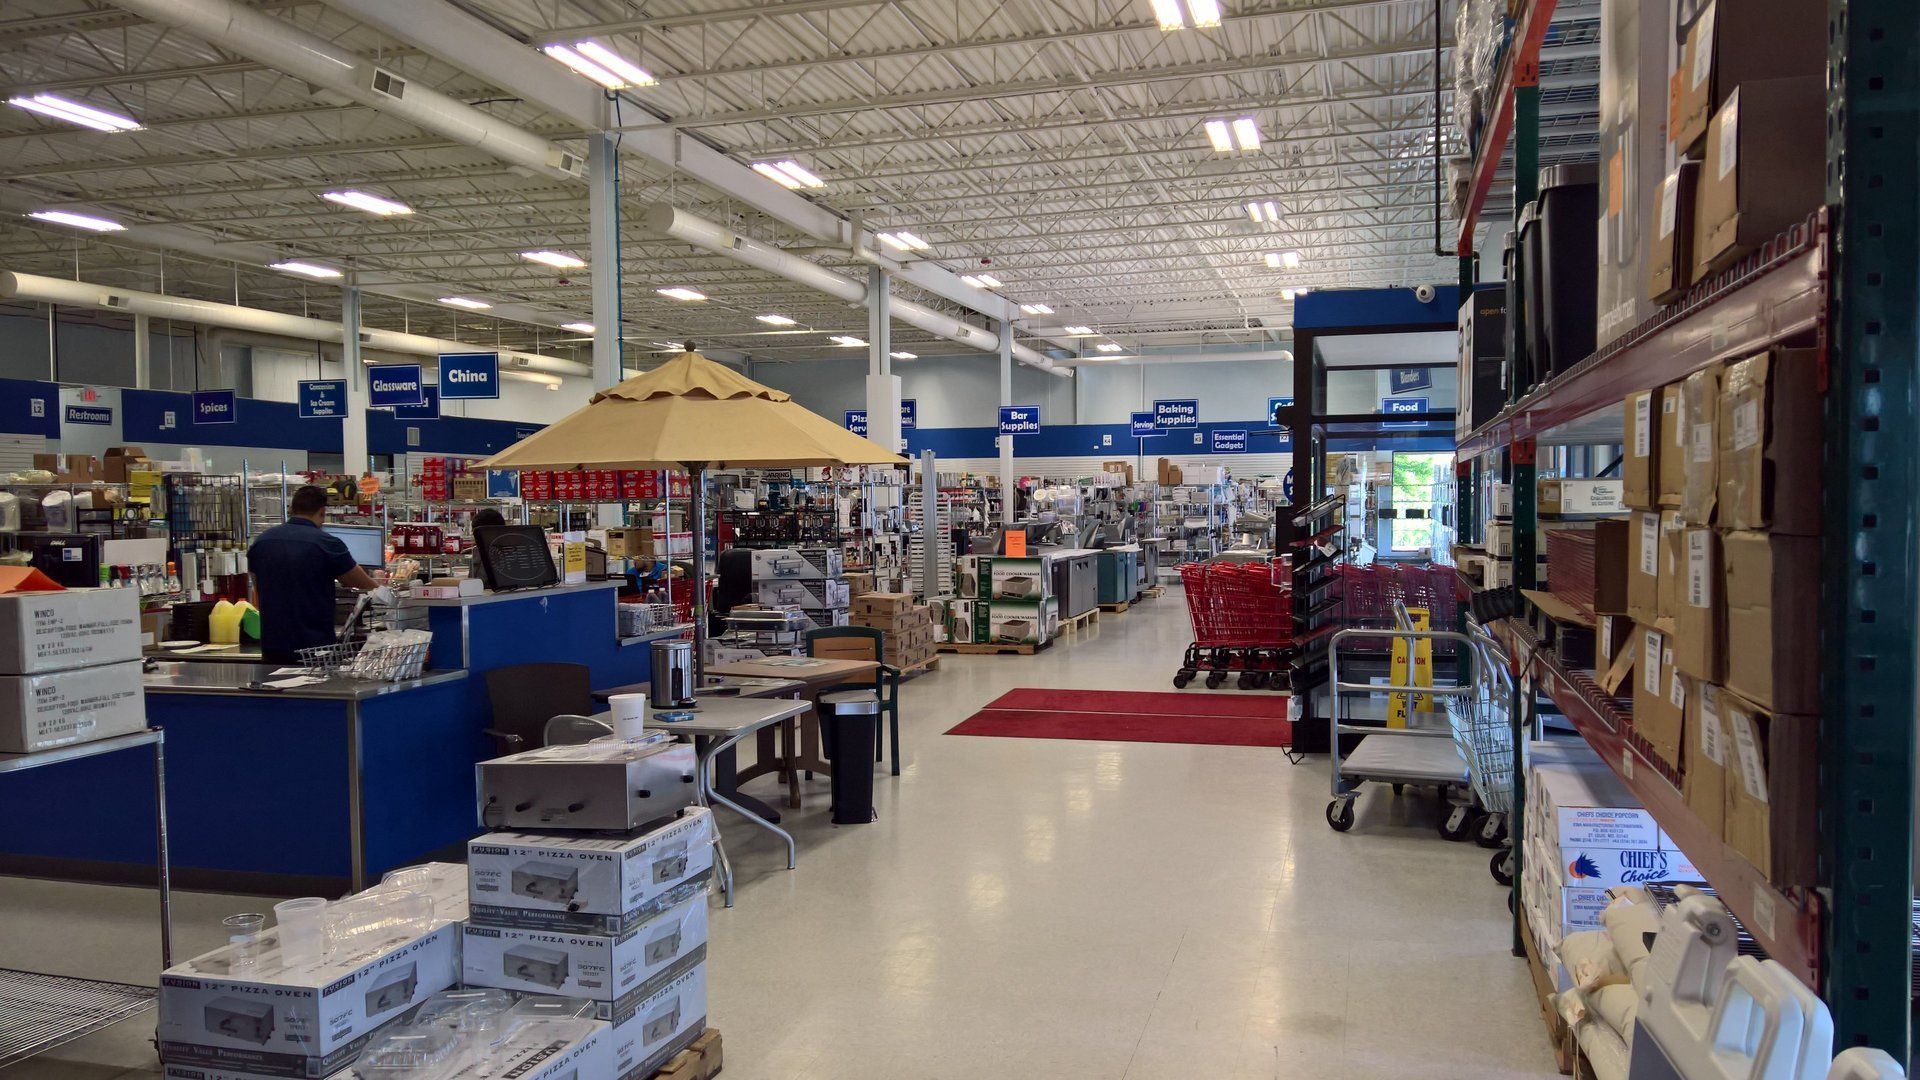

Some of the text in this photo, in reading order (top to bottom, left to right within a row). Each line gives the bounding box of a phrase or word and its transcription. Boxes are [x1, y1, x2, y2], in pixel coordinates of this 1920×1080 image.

[1480, 308, 1499, 316] open
[448, 369, 488, 382] China
[372, 379, 418, 392] Glassware
[200, 402, 228, 414] Spices
[1158, 404, 1194, 414] Baking
[1392, 402, 1419, 412] Food
[69, 408, 110, 422] Restrooms
[1011, 411, 1028, 420] Bar
[1156, 414, 1196, 425] Supplies
[1001, 421, 1038, 432] Supplies
[1134, 420, 1154, 430] Serving
[1214, 433, 1245, 441] Essential
[1214, 441, 1244, 450] Gadgets
[34, 608, 55, 619] WINCO
[1396, 656, 1426, 665] CAION
[35, 686, 57, 697] WINCO
[1402, 701, 1418, 709] WT
[662, 827, 682, 841] PIZZA
[684, 819, 702, 831] OVEN
[471, 846, 509, 856] FUSION
[538, 851, 574, 859] PIZZA
[579, 853, 613, 862] OVEN
[1620, 850, 1668, 870] CHIEF'S
[1620, 869, 1669, 884] Choice
[529, 934, 565, 944] PIZZA
[570, 938, 604, 948] OVEN
[379, 949, 409, 968] PIZZA
[412, 934, 438, 951] OVEN
[231, 985, 269, 995] PIZZA
[274, 989, 312, 998] OVEN
[652, 985, 674, 1002] PIZZA
[675, 970, 695, 986] OVEN
[543, 1038, 598, 1079] PIZZA OVEN
